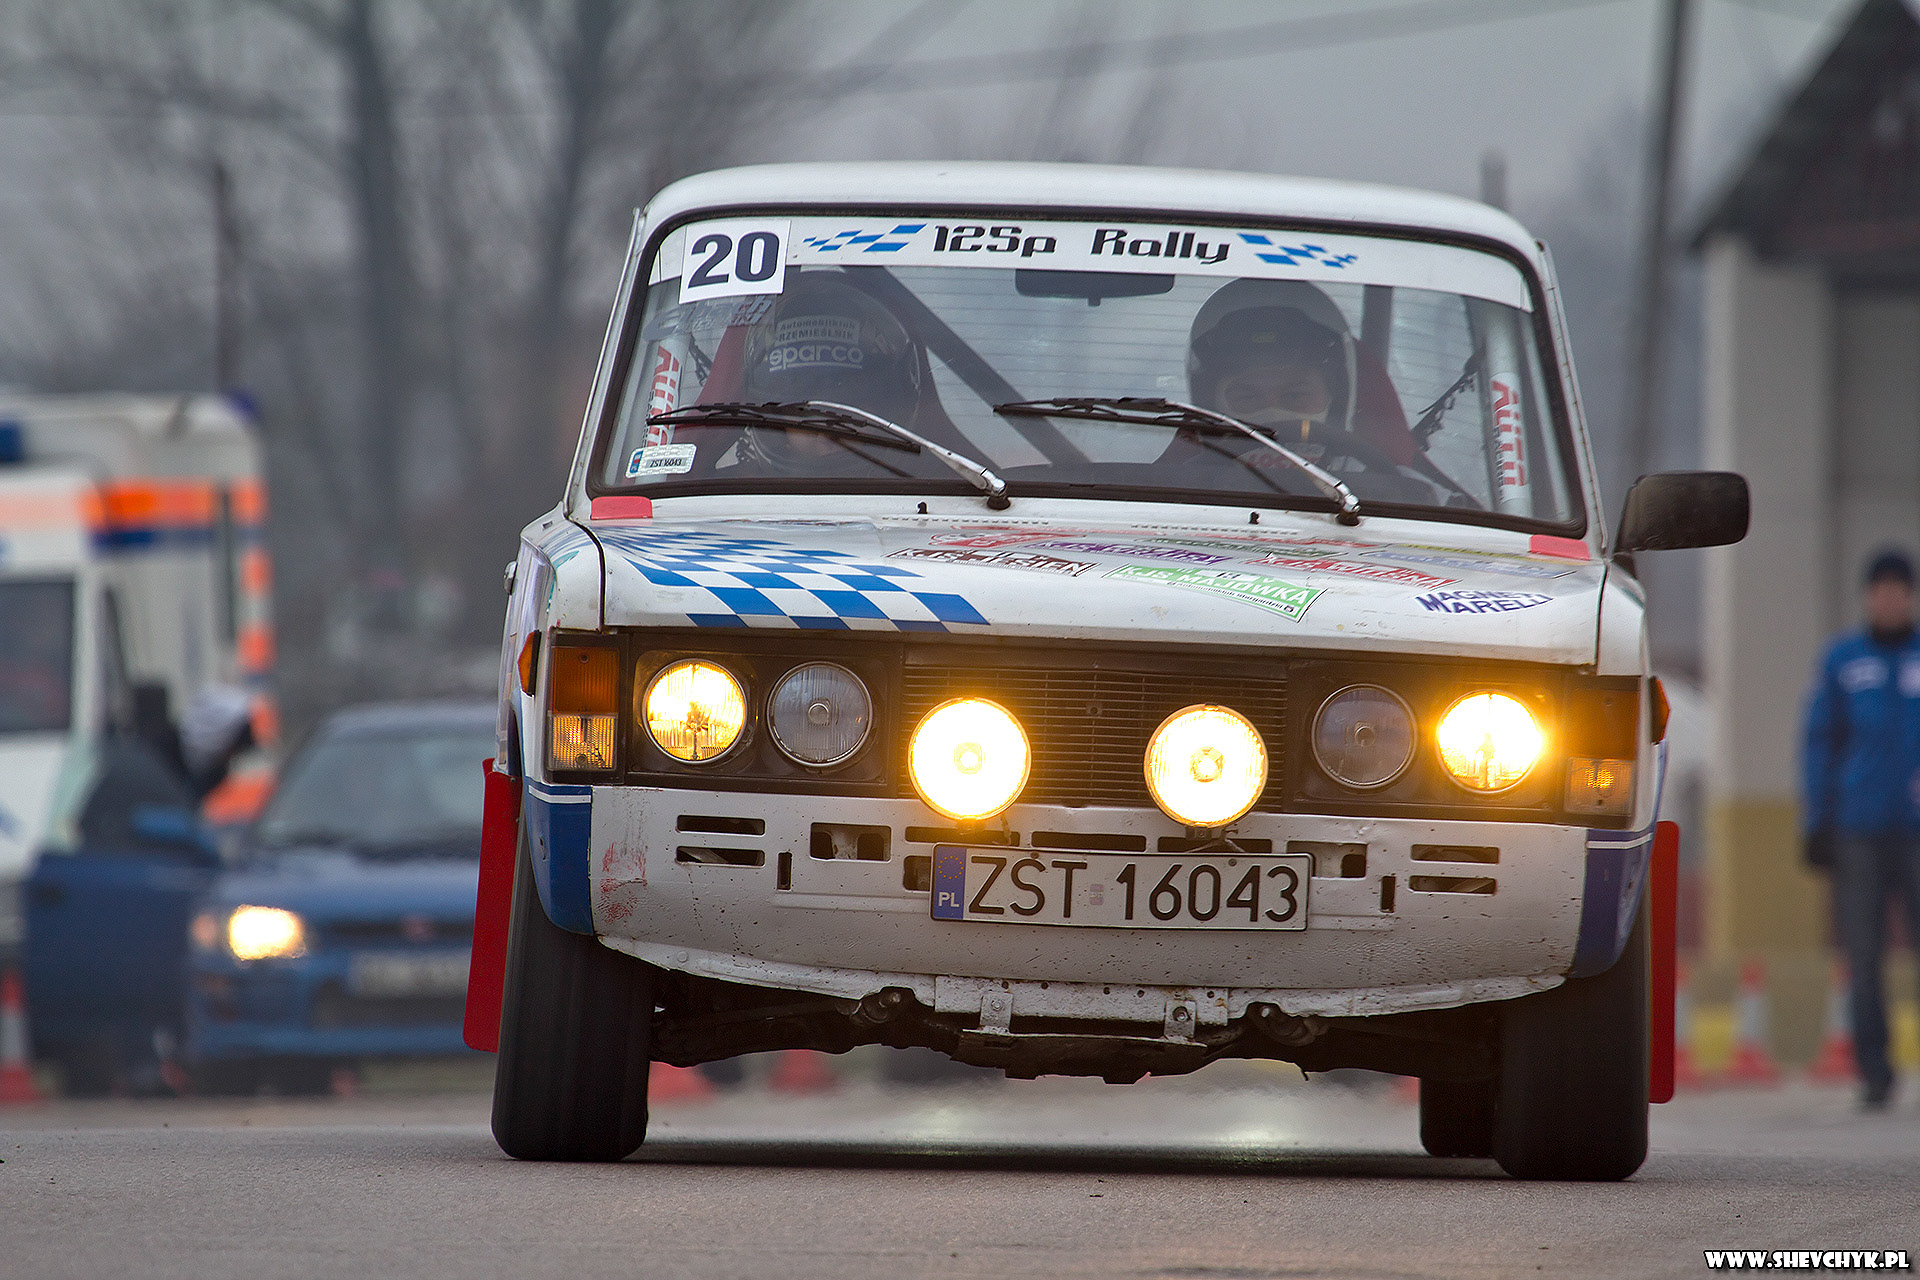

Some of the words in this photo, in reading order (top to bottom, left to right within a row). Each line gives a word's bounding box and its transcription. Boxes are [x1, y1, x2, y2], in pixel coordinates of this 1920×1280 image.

[688, 231, 780, 288] 20
[932, 225, 1056, 257] 125p
[1090, 228, 1231, 264] Rally
[769, 345, 864, 370] sparco
[1119, 566, 1174, 578] KJS
[938, 891, 960, 908] PL
[968, 855, 1088, 918] ZST
[1116, 863, 1299, 923] 16043
